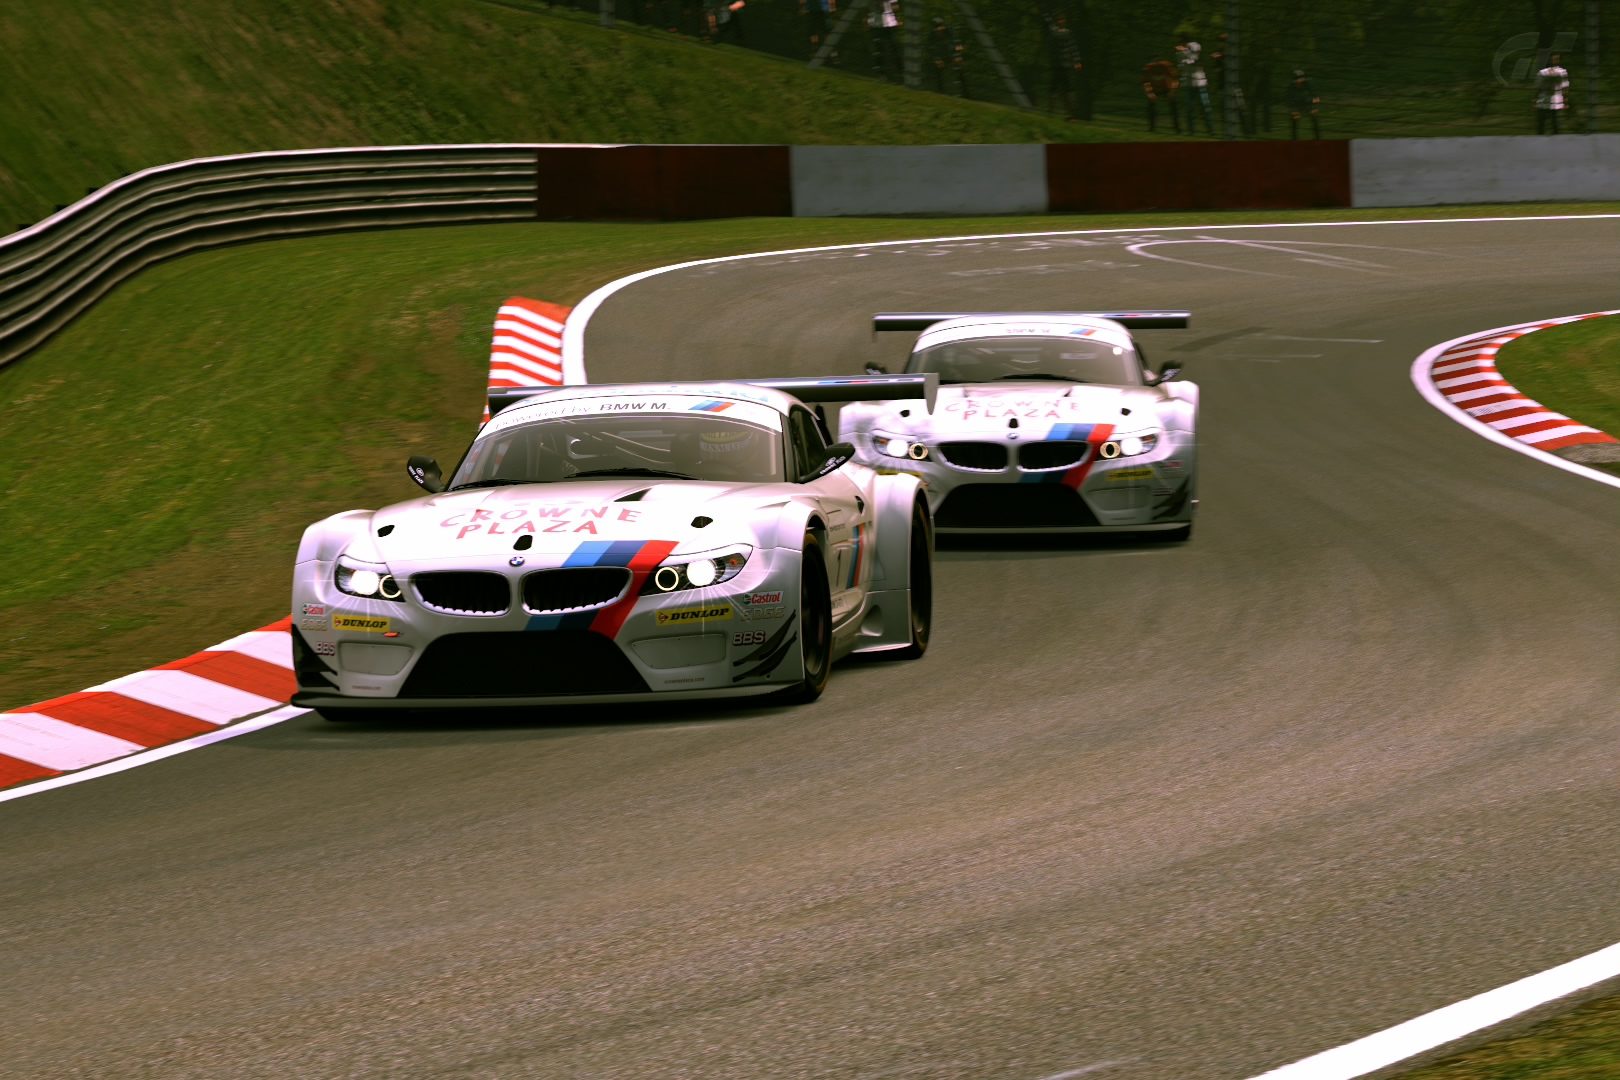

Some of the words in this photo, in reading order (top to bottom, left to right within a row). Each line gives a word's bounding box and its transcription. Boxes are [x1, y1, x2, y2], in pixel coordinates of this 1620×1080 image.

[600, 402, 646, 411] BMW
[650, 402, 667, 410] M
[962, 408, 1061, 421] PLAZA
[440, 506, 642, 528] CROWNE
[456, 519, 598, 540] PLAZA
[751, 591, 781, 604] Castrol
[670, 607, 729, 621] DUNLOP
[342, 618, 388, 629] DUNLOP
[732, 630, 766, 646] BBS
[316, 641, 335, 656] BBS
